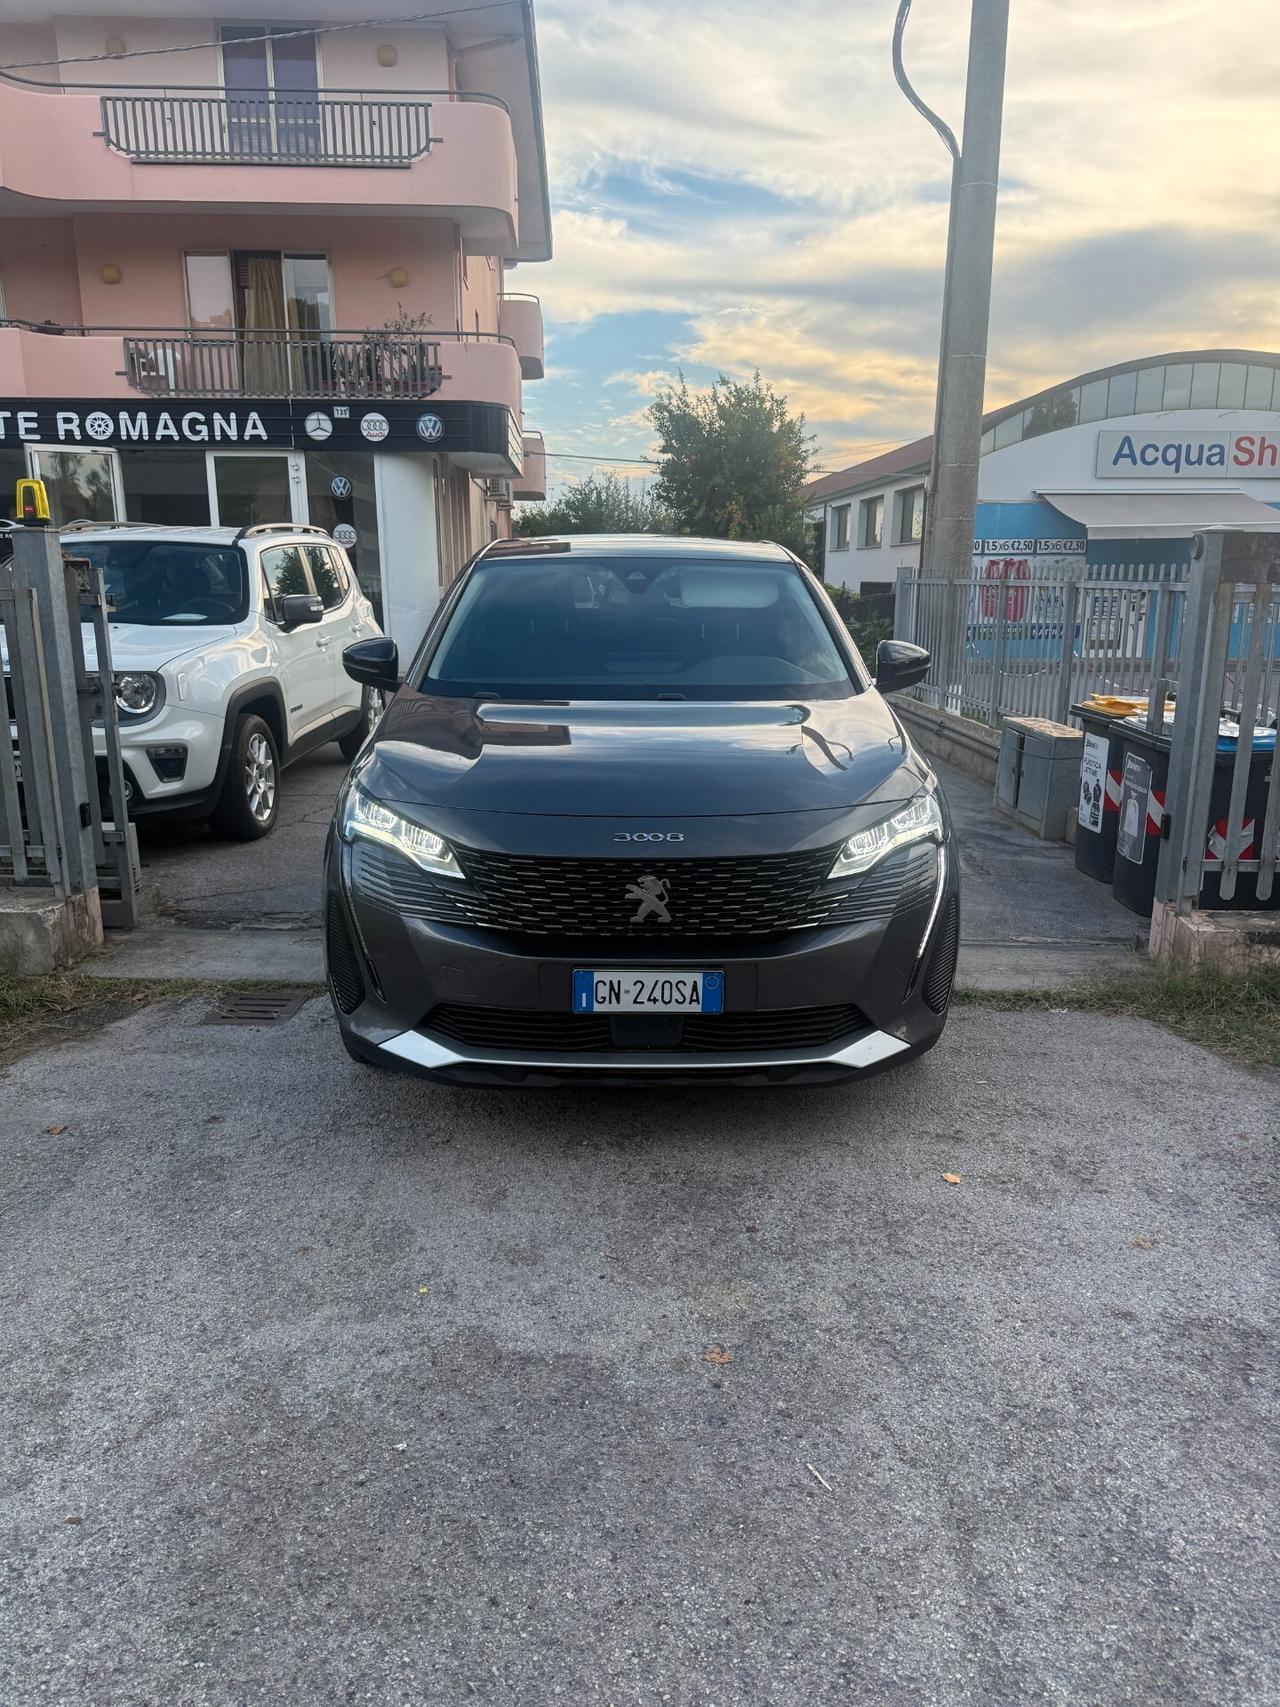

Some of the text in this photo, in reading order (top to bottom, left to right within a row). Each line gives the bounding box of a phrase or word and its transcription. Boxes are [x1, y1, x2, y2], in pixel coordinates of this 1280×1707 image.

[56, 411, 268, 441] ROMAGNA
[1112, 435, 1225, 474] Acqua
[613, 832, 685, 842] 3008
[595, 979, 701, 1005] GN 240SA
